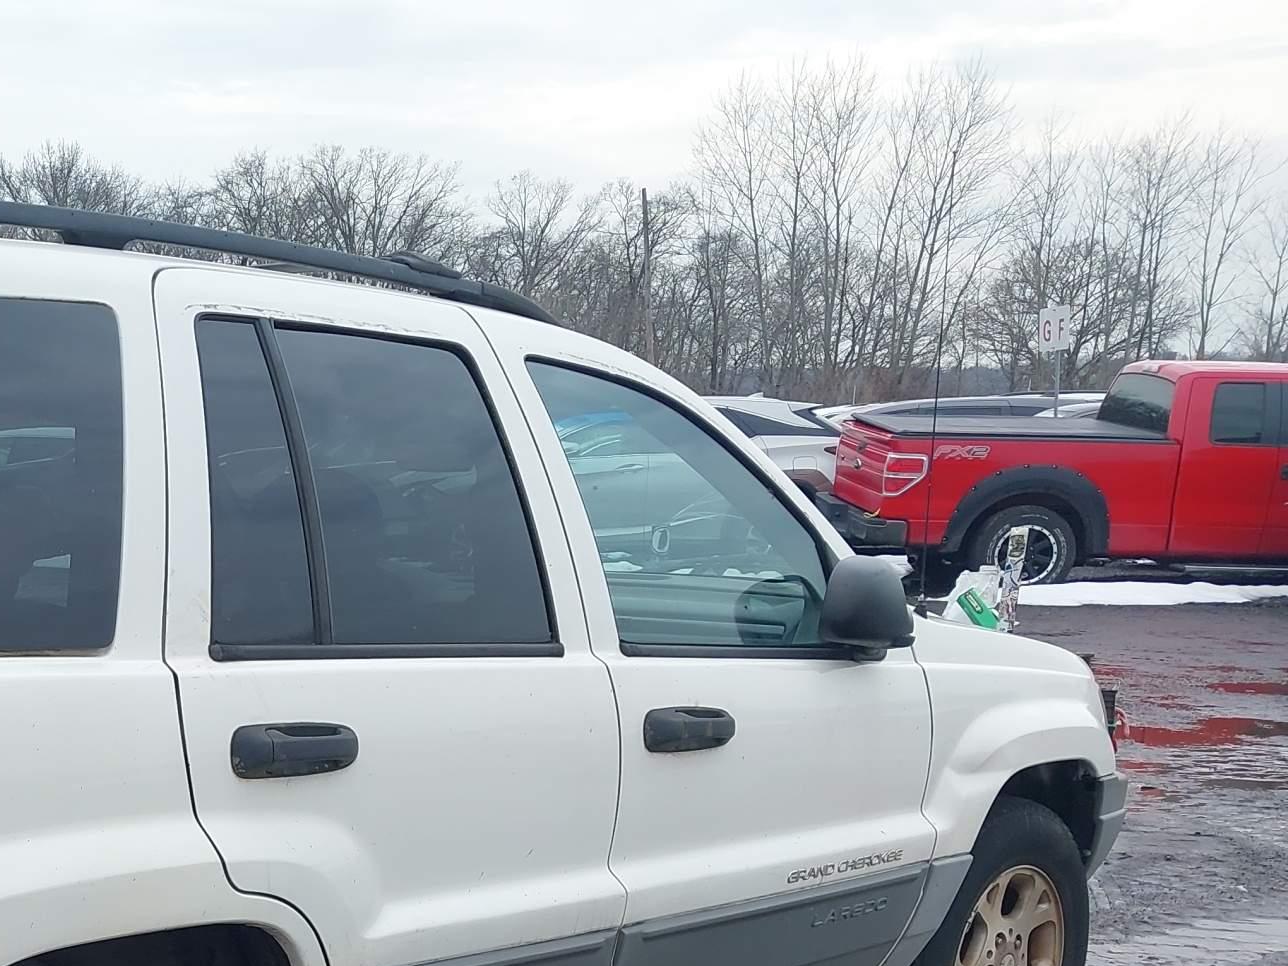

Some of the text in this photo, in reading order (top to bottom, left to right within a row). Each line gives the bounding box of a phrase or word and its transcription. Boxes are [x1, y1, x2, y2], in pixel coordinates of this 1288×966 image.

[1043, 318, 1065, 342] G F
[933, 445, 991, 460] FX2
[787, 849, 904, 884] GRAND CHEROKEE
[811, 897, 888, 928] LAREDO
